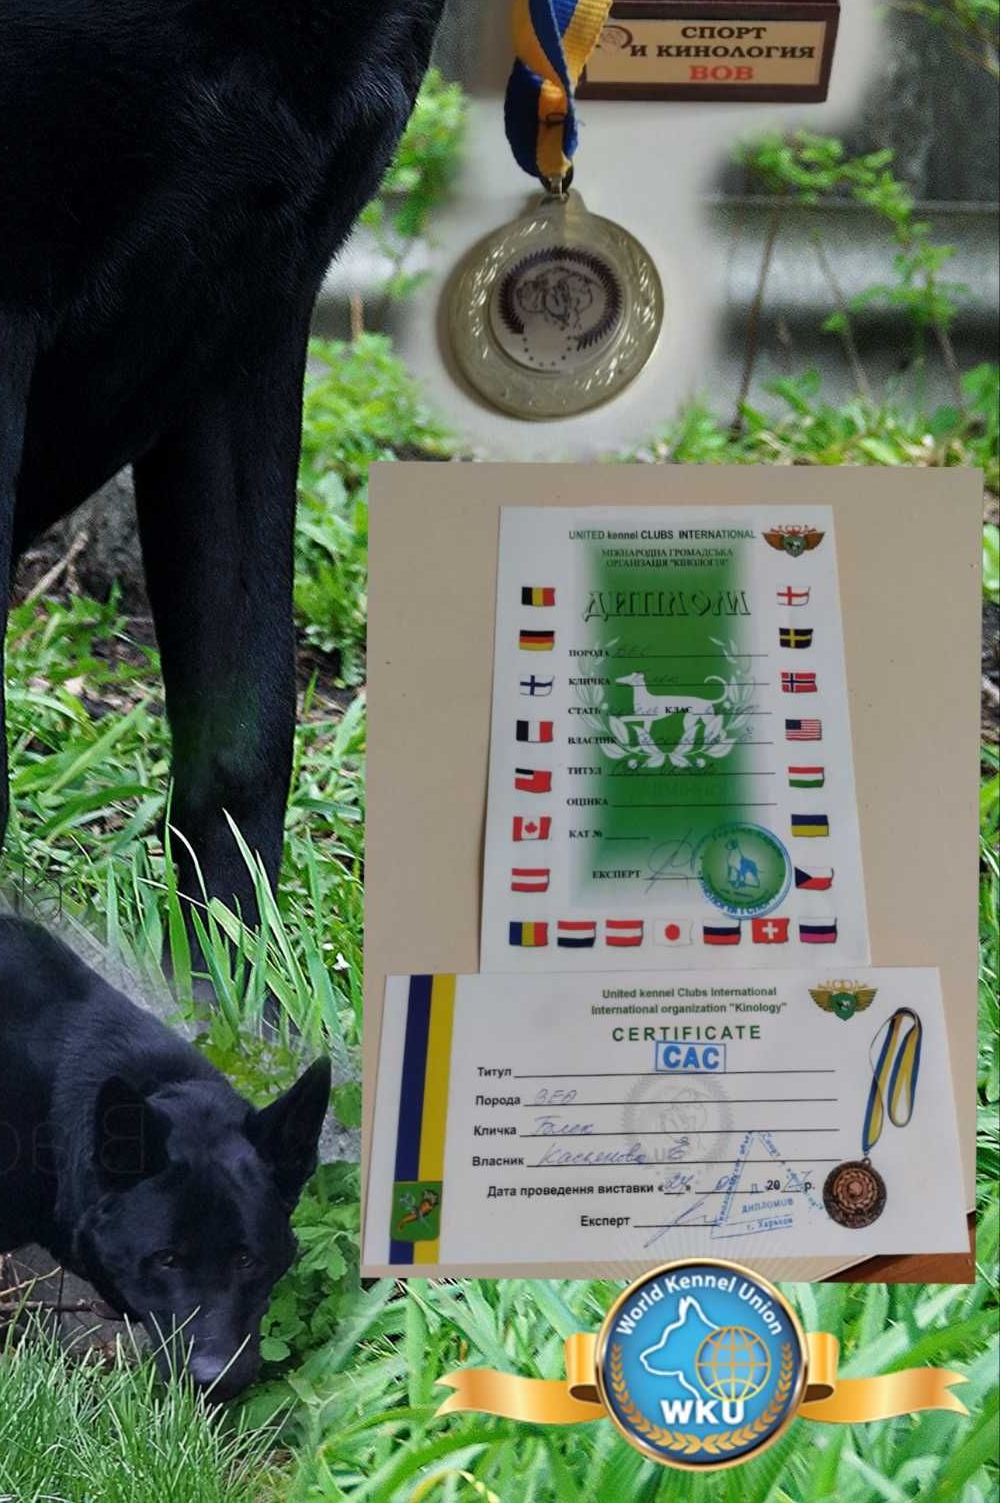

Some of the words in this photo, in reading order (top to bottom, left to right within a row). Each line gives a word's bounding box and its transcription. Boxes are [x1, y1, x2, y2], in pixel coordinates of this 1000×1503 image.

[681, 26, 766, 40] СПОРТ
[630, 45, 647, 58] И
[656, 44, 814, 59] КИНОЛОГИЯ
[569, 530, 605, 540] UNITED
[607, 530, 639, 540] kennel
[641, 529, 674, 540] CLUBS
[678, 529, 757, 540] INTERNATIONAL
[584, 590, 752, 623] ДИПЛОМ
[665, 706, 693, 714] КЛАС
[592, 870, 641, 880] ЕКСПЕРТ
[602, 988, 637, 1000] United
[638, 988, 675, 999] kennel
[677, 987, 709, 998] Clubs
[710, 986, 777, 998] International
[591, 1004, 658, 1016] International
[660, 1003, 727, 1015] organization
[729, 1001, 788, 1014] "Kinology"
[611, 1025, 762, 1042] CERTIFICATE
[662, 1044, 720, 1070] CAC
[476, 1067, 512, 1078] Титул
[475, 1095, 521, 1108] Порода
[473, 1124, 517, 1137] Кличка
[472, 1155, 525, 1167] Власник
[487, 1185, 517, 1199] Дата
[519, 1184, 594, 1197] проведення
[597, 1182, 654, 1194] виставки
[580, 1214, 631, 1228] Експерт
